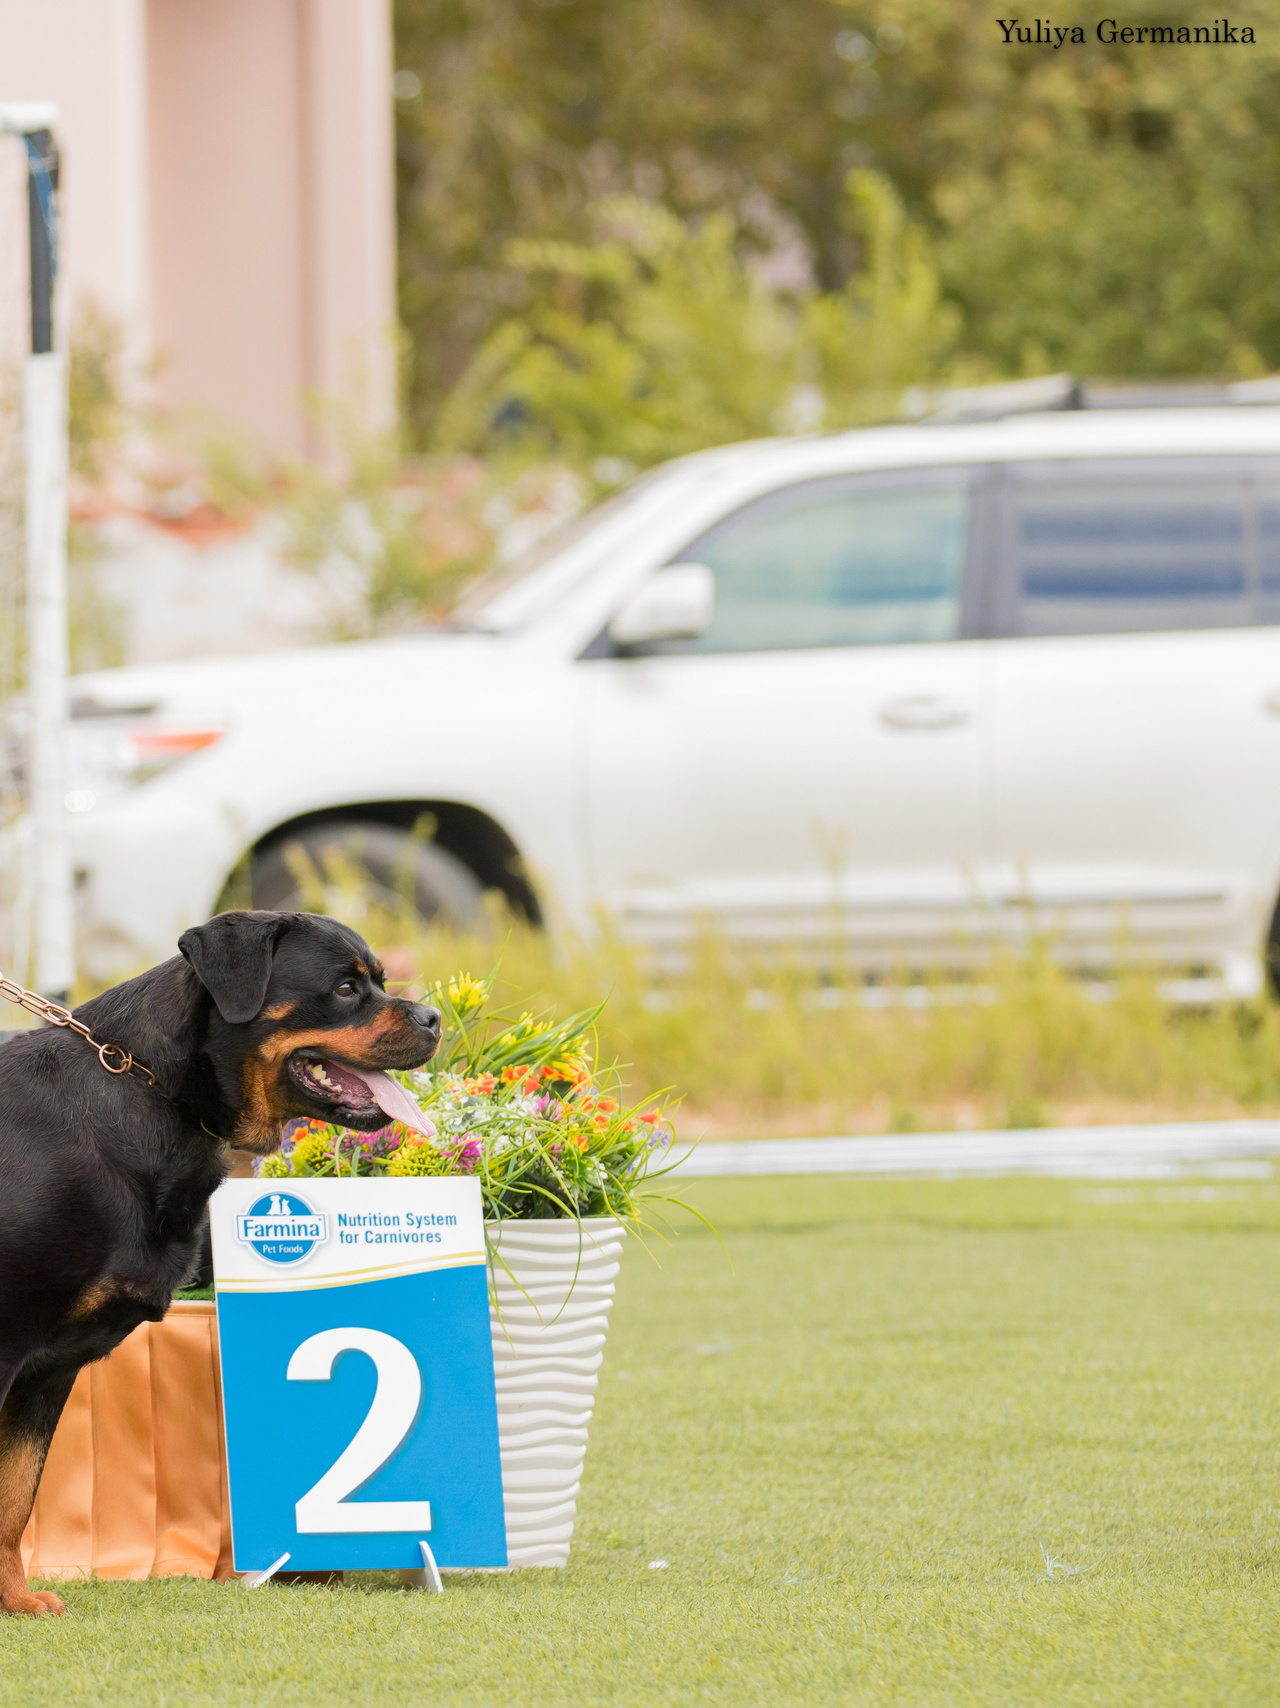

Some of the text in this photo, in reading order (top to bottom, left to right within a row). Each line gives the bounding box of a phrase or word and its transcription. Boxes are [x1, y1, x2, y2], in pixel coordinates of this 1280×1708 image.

[243, 1219, 320, 1238] Farmina
[338, 1212, 457, 1229] Nutrition System
[339, 1229, 442, 1244] for Carnivores
[262, 1244, 304, 1254] Pet Foods
[286, 1326, 432, 1534] 2
